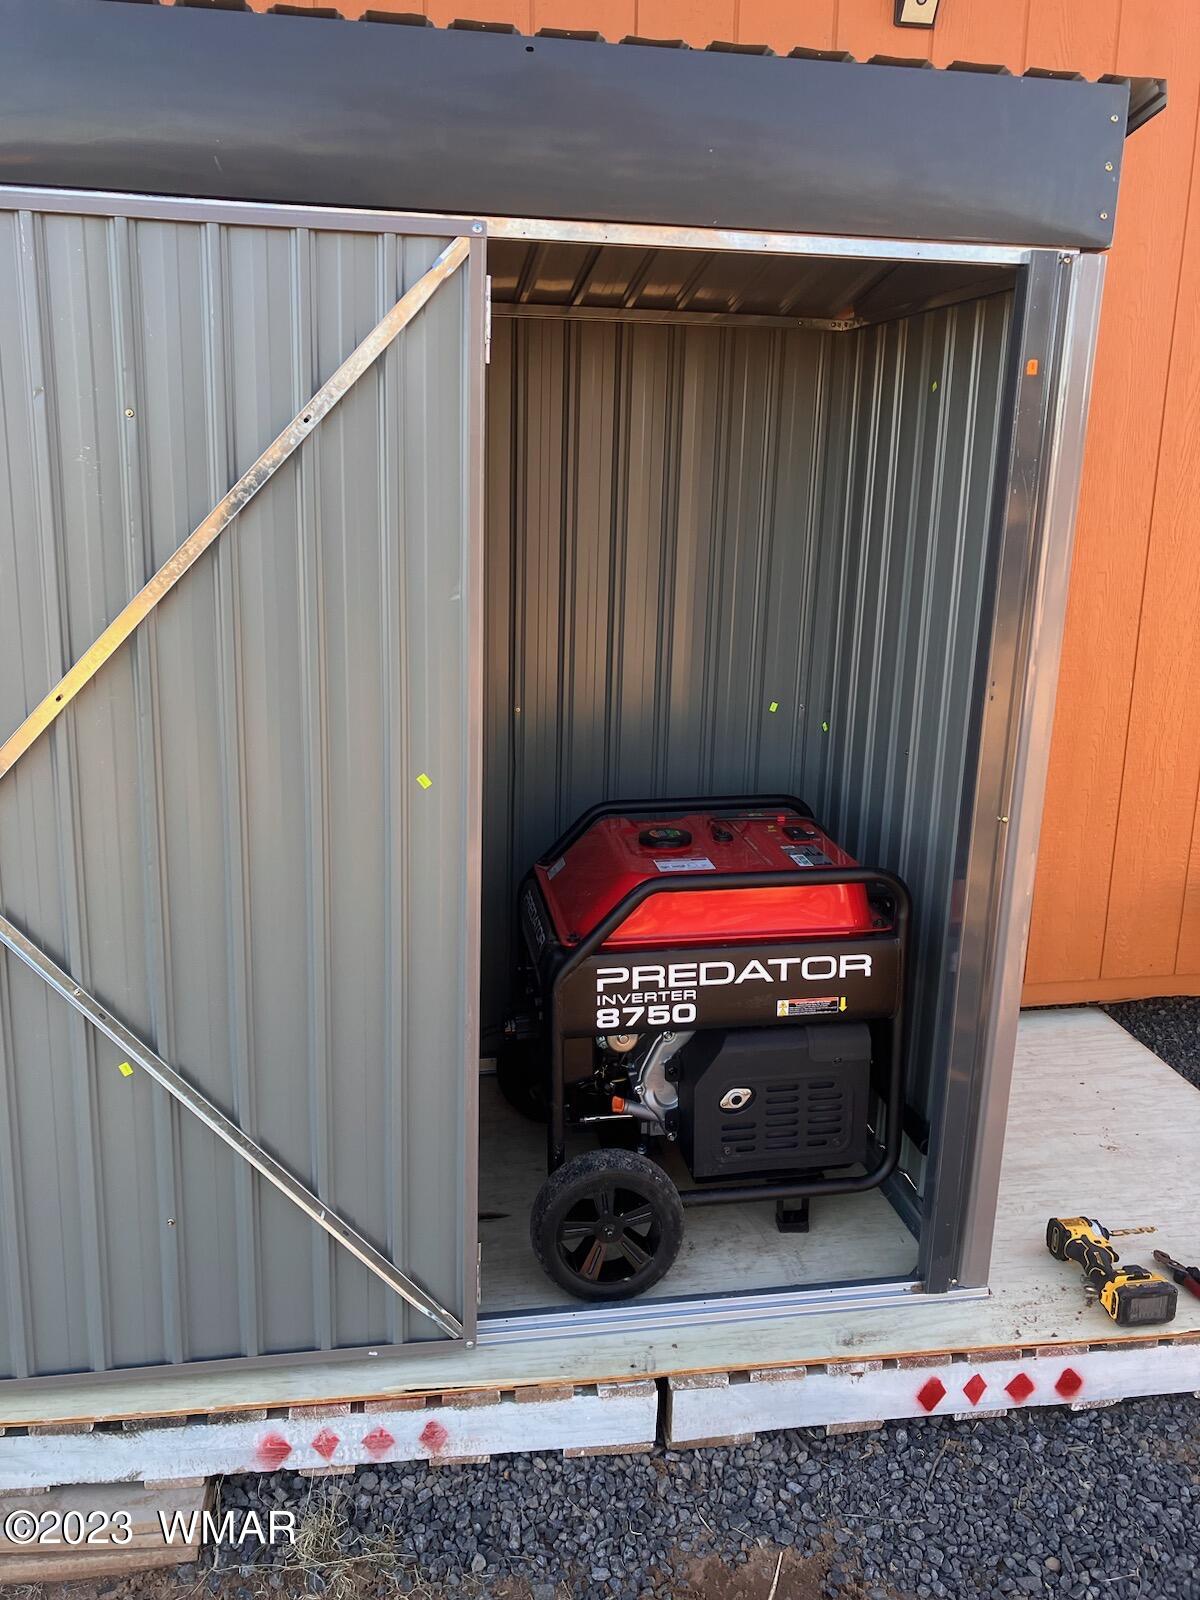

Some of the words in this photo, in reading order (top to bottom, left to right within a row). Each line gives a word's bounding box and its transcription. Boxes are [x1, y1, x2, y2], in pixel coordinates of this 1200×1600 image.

[596, 954, 872, 992] PREDATOR
[597, 989, 697, 1006] INVERTER
[596, 1003, 697, 1029] 8750
